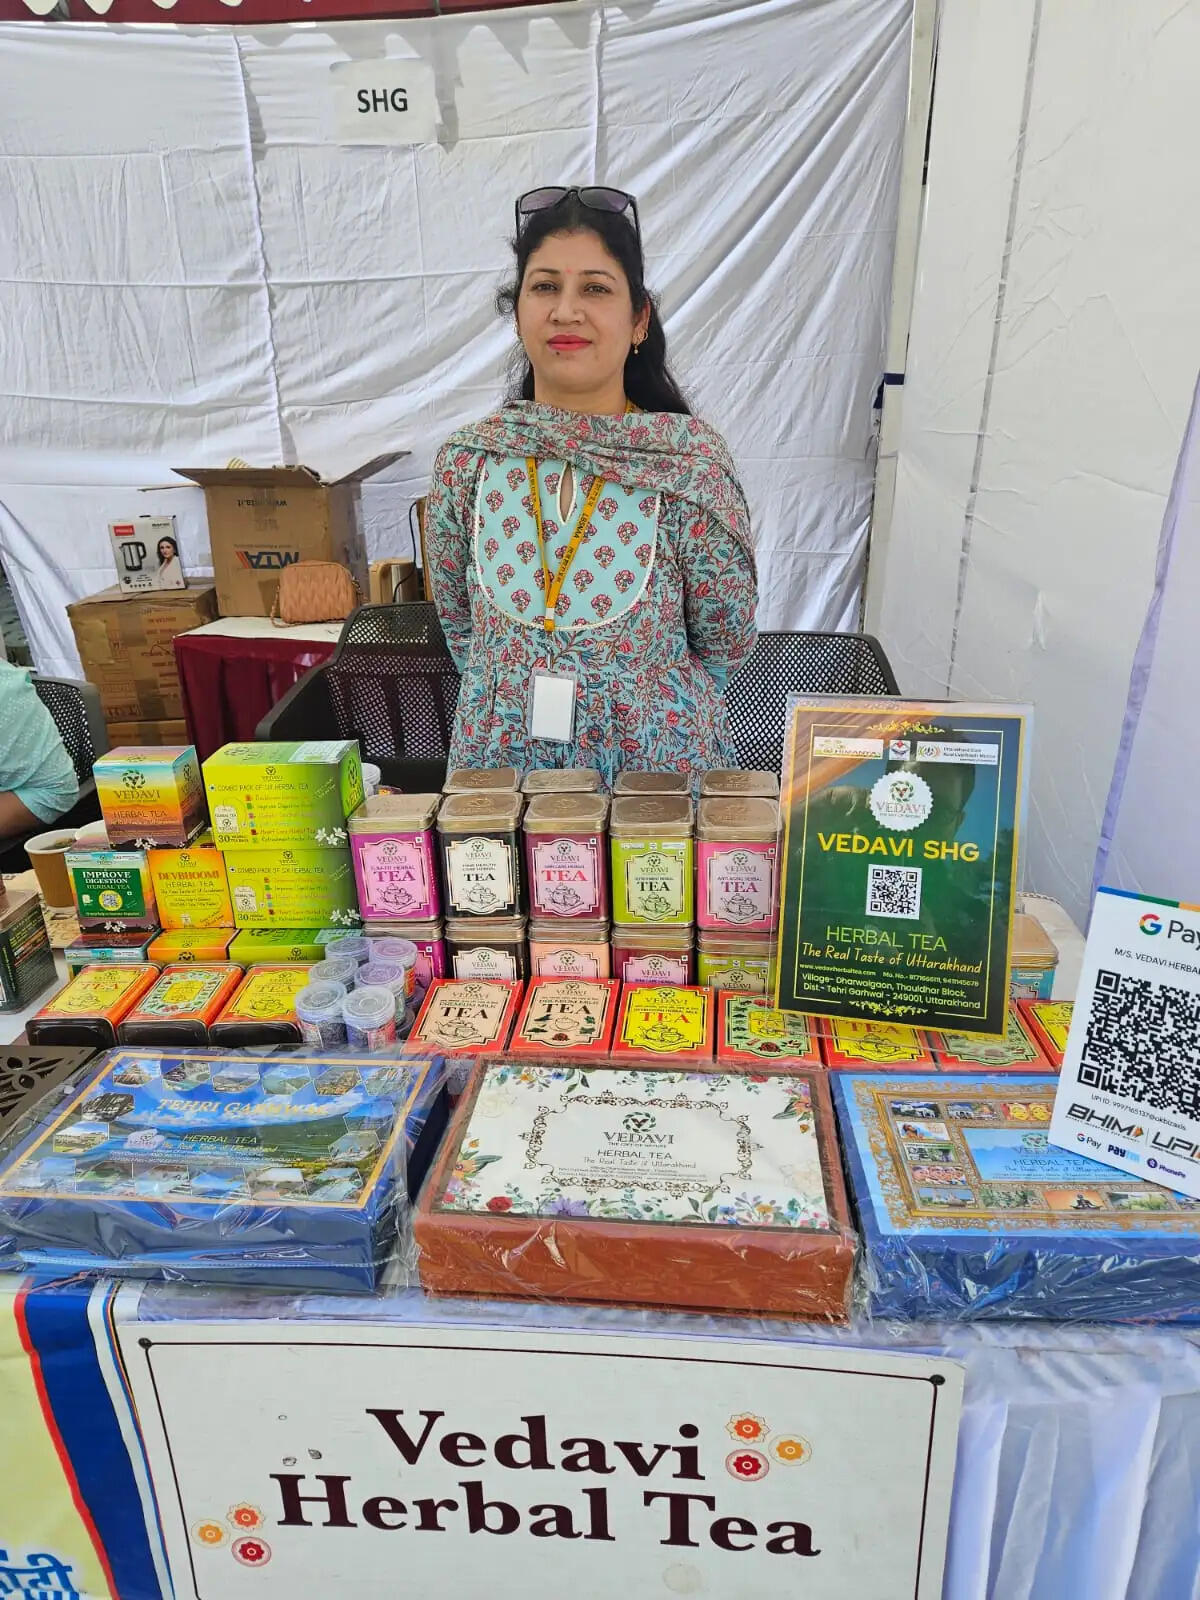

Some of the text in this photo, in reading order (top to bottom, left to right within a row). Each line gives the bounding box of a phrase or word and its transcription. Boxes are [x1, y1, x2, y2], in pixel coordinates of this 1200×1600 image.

[357, 88, 408, 113] SHG
[113, 790, 160, 800] VEDAVI
[876, 800, 926, 814] VEDAVI
[817, 832, 980, 862] VEDAVI SHG
[158, 870, 219, 880] DEVBHOOMI
[373, 870, 416, 882] TEA
[464, 873, 495, 881] TEA
[541, 870, 587, 882] TEA
[636, 881, 670, 892] TEA
[721, 881, 758, 893] TEA
[826, 925, 948, 952] HERBAL TEA
[802, 942, 983, 974] The Real Taste of Uttarakhand
[1114, 947, 1133, 960] M/S.
[1135, 953, 1166, 966] VEDAVI
[802, 973, 967, 998] Village- Dharwalgaon, Thauldhar Block,
[826, 985, 847, 994] Tehri
[848, 988, 884, 998] Garhwal
[892, 993, 923, 1004] 249001,
[925, 996, 980, 1009] Uttarakhand
[441, 1006, 488, 1019] TEA
[542, 1004, 591, 1015] TEA
[640, 1012, 691, 1024] TEA
[844, 1019, 900, 1034] TEA
[1091, 1094, 1102, 1102] UPI
[157, 1099, 219, 1113] TEHRI
[1067, 1103, 1136, 1136] BHIM
[1152, 1131, 1199, 1158] UPI
[183, 1134, 257, 1144] HERBAL TEA
[604, 1131, 674, 1144] VEDAVI
[1086, 1136, 1102, 1149] Pay
[598, 1150, 672, 1160] HERBAL TEA
[1159, 1164, 1186, 1178] PhonePe
[366, 1408, 705, 1480] Vedavi
[269, 1473, 822, 1557] Herbal Tea
